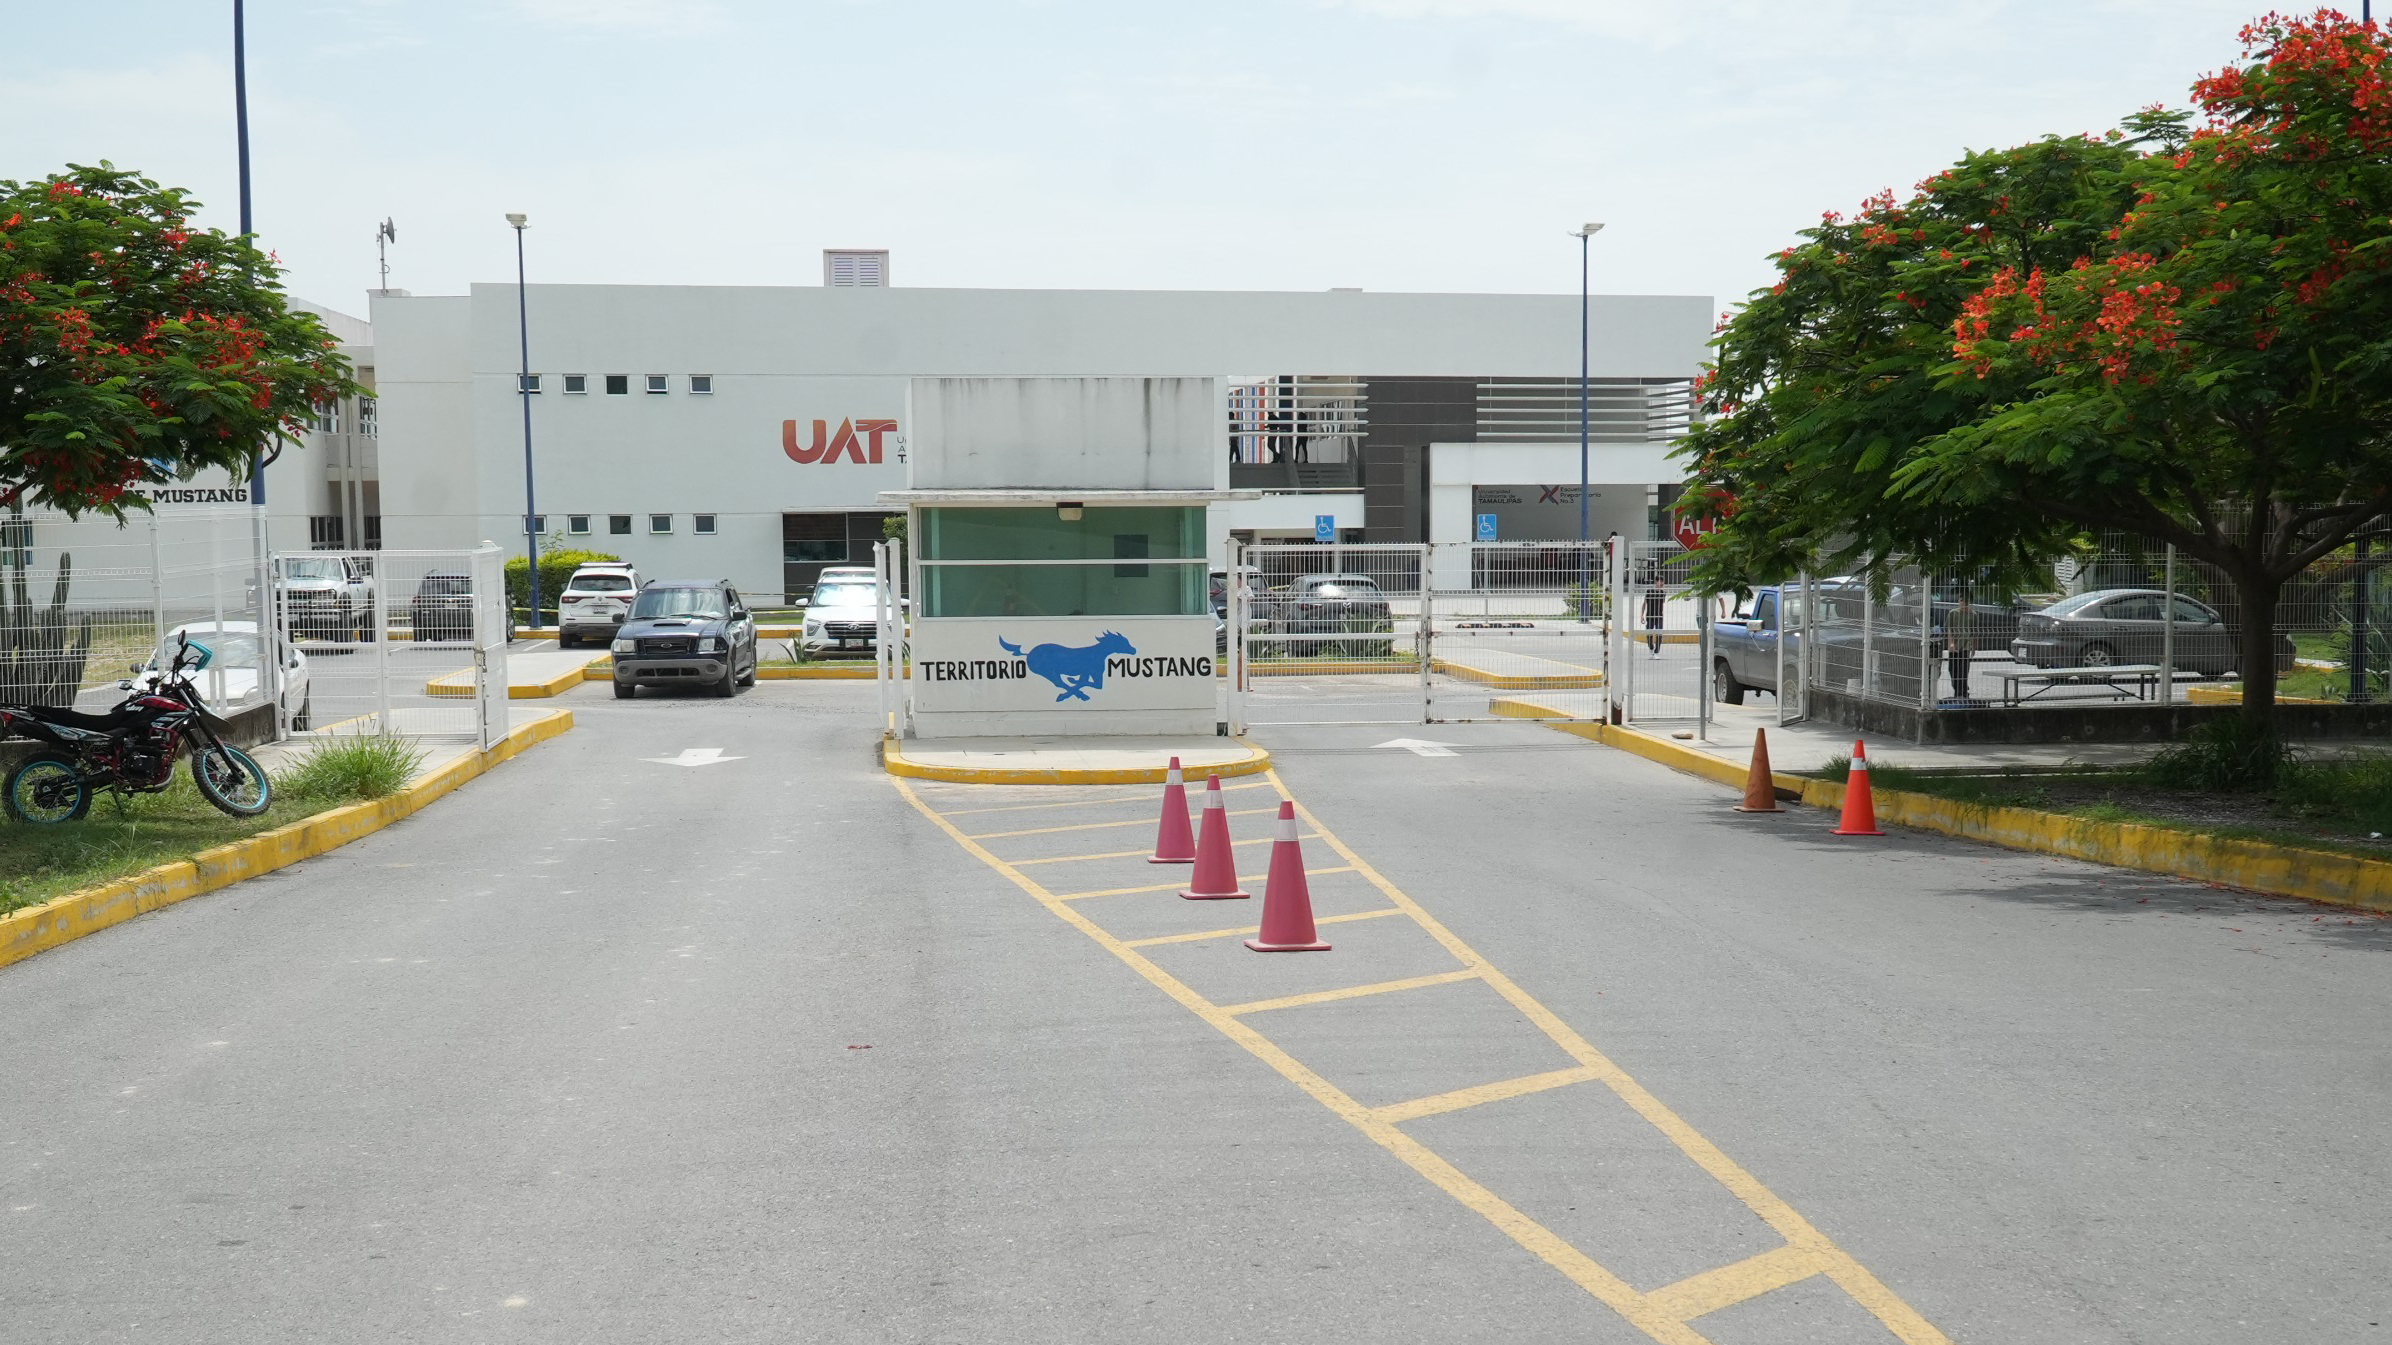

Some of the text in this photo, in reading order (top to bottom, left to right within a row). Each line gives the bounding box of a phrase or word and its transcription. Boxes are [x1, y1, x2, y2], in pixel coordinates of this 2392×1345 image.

[783, 416, 897, 464] UAT
[153, 489, 248, 503] MUSTANG
[920, 657, 1211, 681] TERRITORIO MUSTANG
